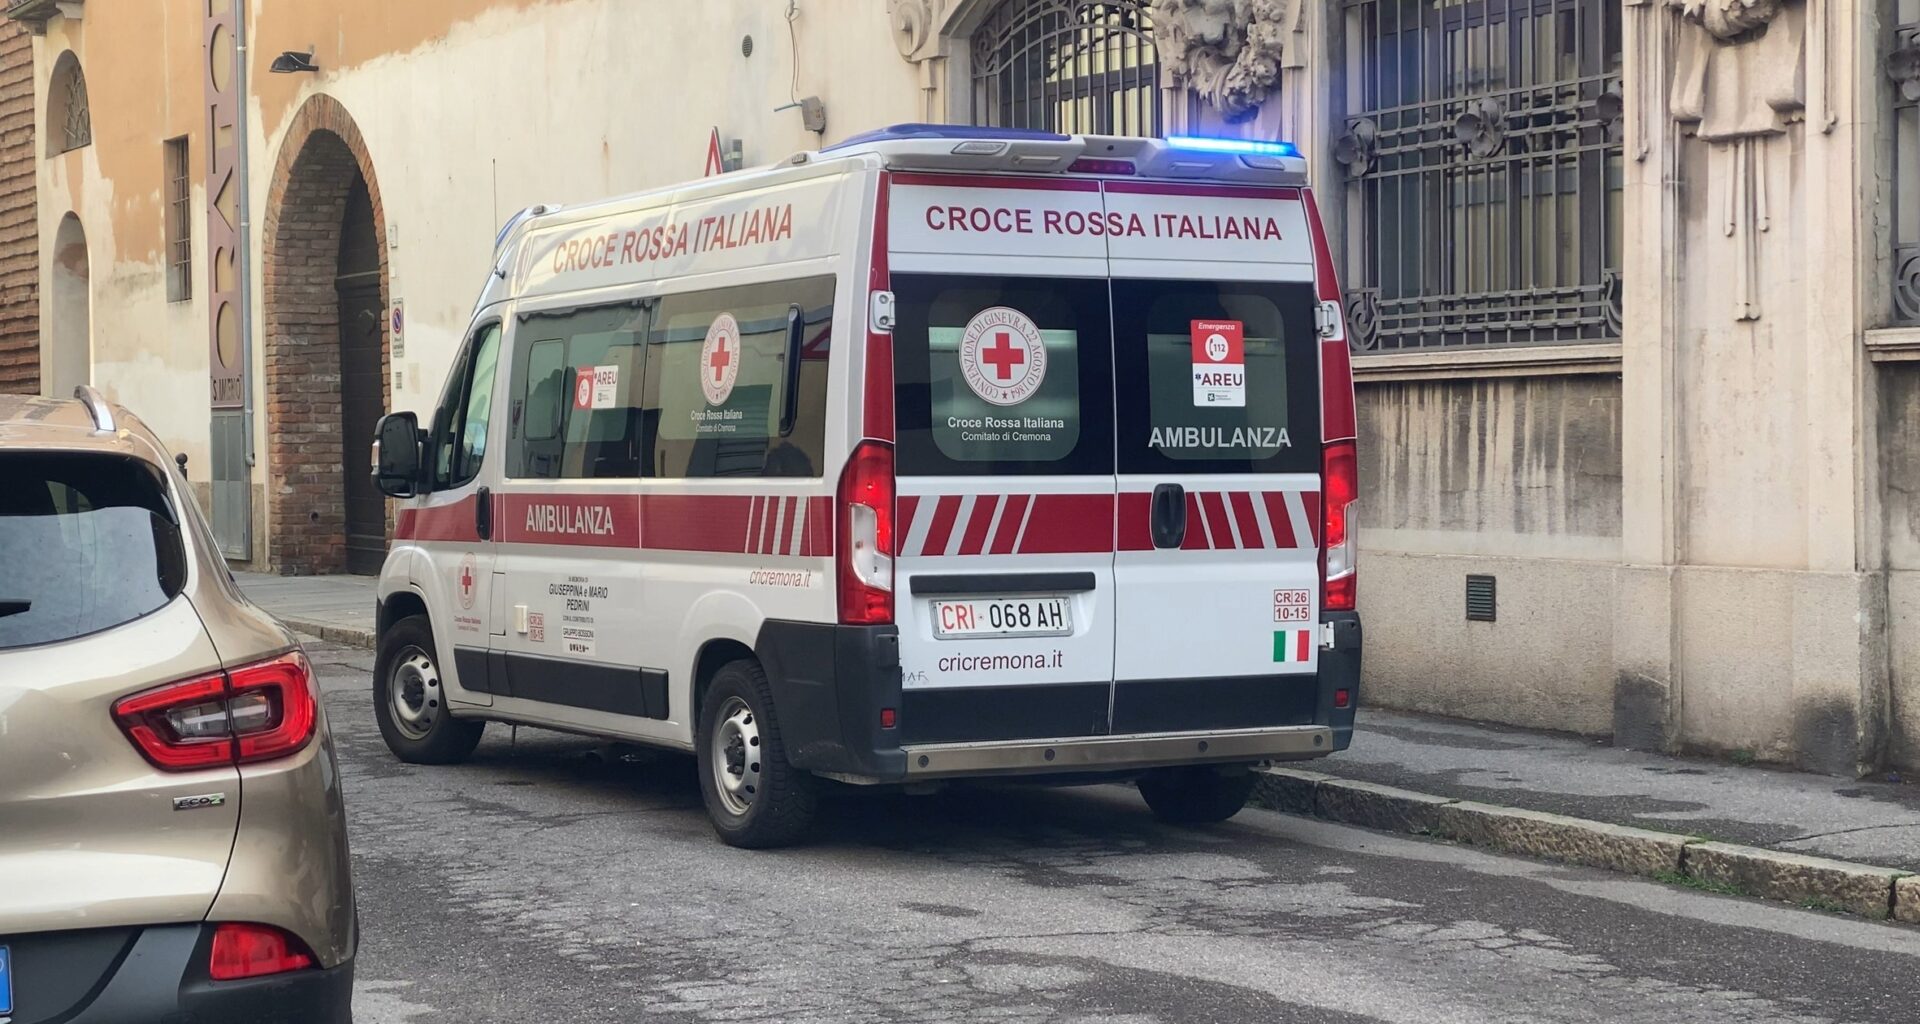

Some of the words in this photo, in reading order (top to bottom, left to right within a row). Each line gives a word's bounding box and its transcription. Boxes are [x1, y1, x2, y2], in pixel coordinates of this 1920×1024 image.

[925, 205, 1033, 234] CROCE
[1043, 209, 1146, 237] ROSSA
[1153, 213, 1282, 241] ITALIANA
[553, 233, 618, 274] CROCE
[620, 222, 688, 265] ROSSA
[693, 203, 792, 254] ITALIANA
[973, 323, 986, 333] DI
[984, 311, 1027, 333] GINEVRA
[1198, 322, 1236, 331] Emergenza
[1026, 330, 1038, 342] 22
[1213, 343, 1226, 353] 112
[963, 331, 999, 399] CONVENZIONE
[1026, 344, 1043, 387] AGOSTO
[596, 370, 618, 385] AREU
[1201, 373, 1243, 387] AREU
[947, 416, 982, 428] Croce
[985, 416, 1021, 428] Rossa
[1023, 416, 1065, 428] Italiana
[961, 431, 1000, 441] Comitato
[1001, 431, 1010, 441] di
[1012, 431, 1051, 441] Cremona
[1147, 426, 1292, 448] AMBULANZA
[525, 504, 615, 536] AMBULANZA
[749, 565, 811, 587] cricremona.it
[549, 583, 583, 597] GIUSEPPINA
[584, 588, 588, 598] e
[588, 585, 608, 599] MARIO
[1275, 592, 1291, 603] CR
[1294, 592, 1307, 603] 26
[566, 598, 590, 612] PEDRINI
[941, 603, 976, 630] CRI
[989, 603, 1031, 628] 068
[1037, 602, 1063, 627] AH
[1275, 607, 1308, 619] 10-15
[938, 649, 1063, 672] cricremona.it
